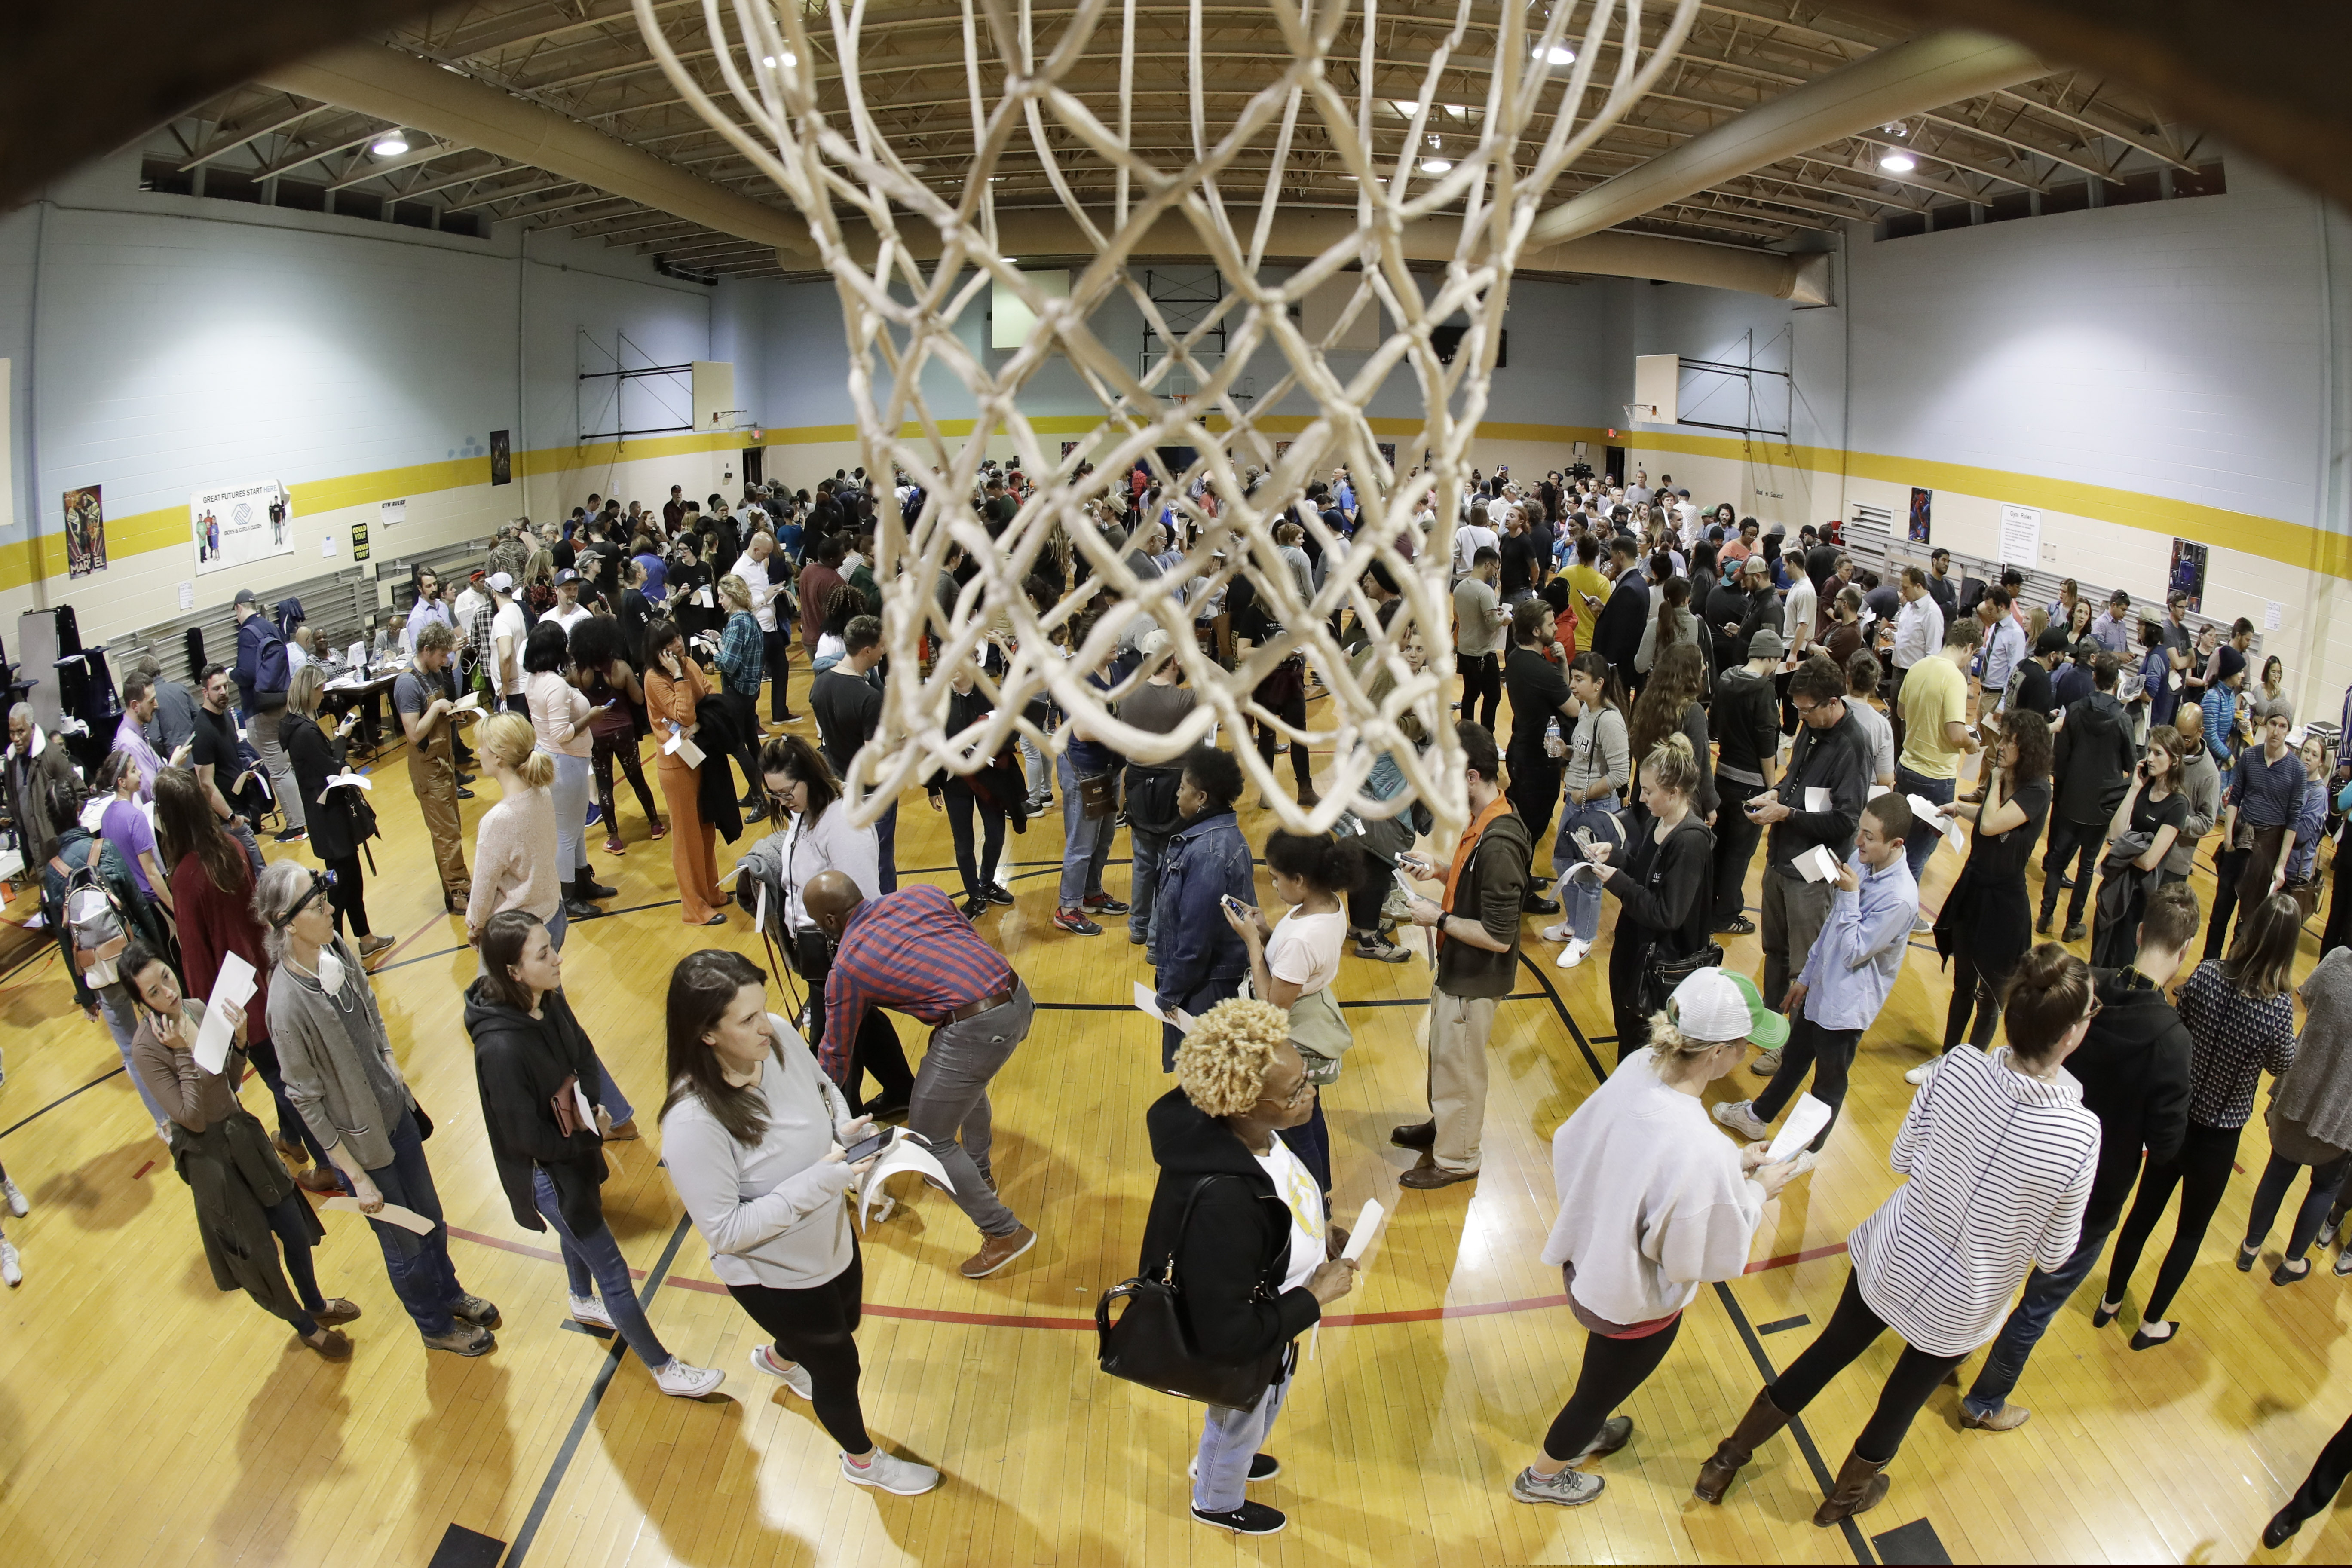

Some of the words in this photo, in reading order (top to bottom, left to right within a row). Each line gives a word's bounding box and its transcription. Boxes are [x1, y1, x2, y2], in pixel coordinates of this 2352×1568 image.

[203, 494, 220, 503] GREAT
[221, 490, 245, 500] FUTURES
[247, 487, 262, 496] START
[352, 525, 367, 534] COULD
[354, 532, 366, 541] YOU?
[354, 543, 369, 553] SHOULD
[355, 549, 369, 559] YOU?
